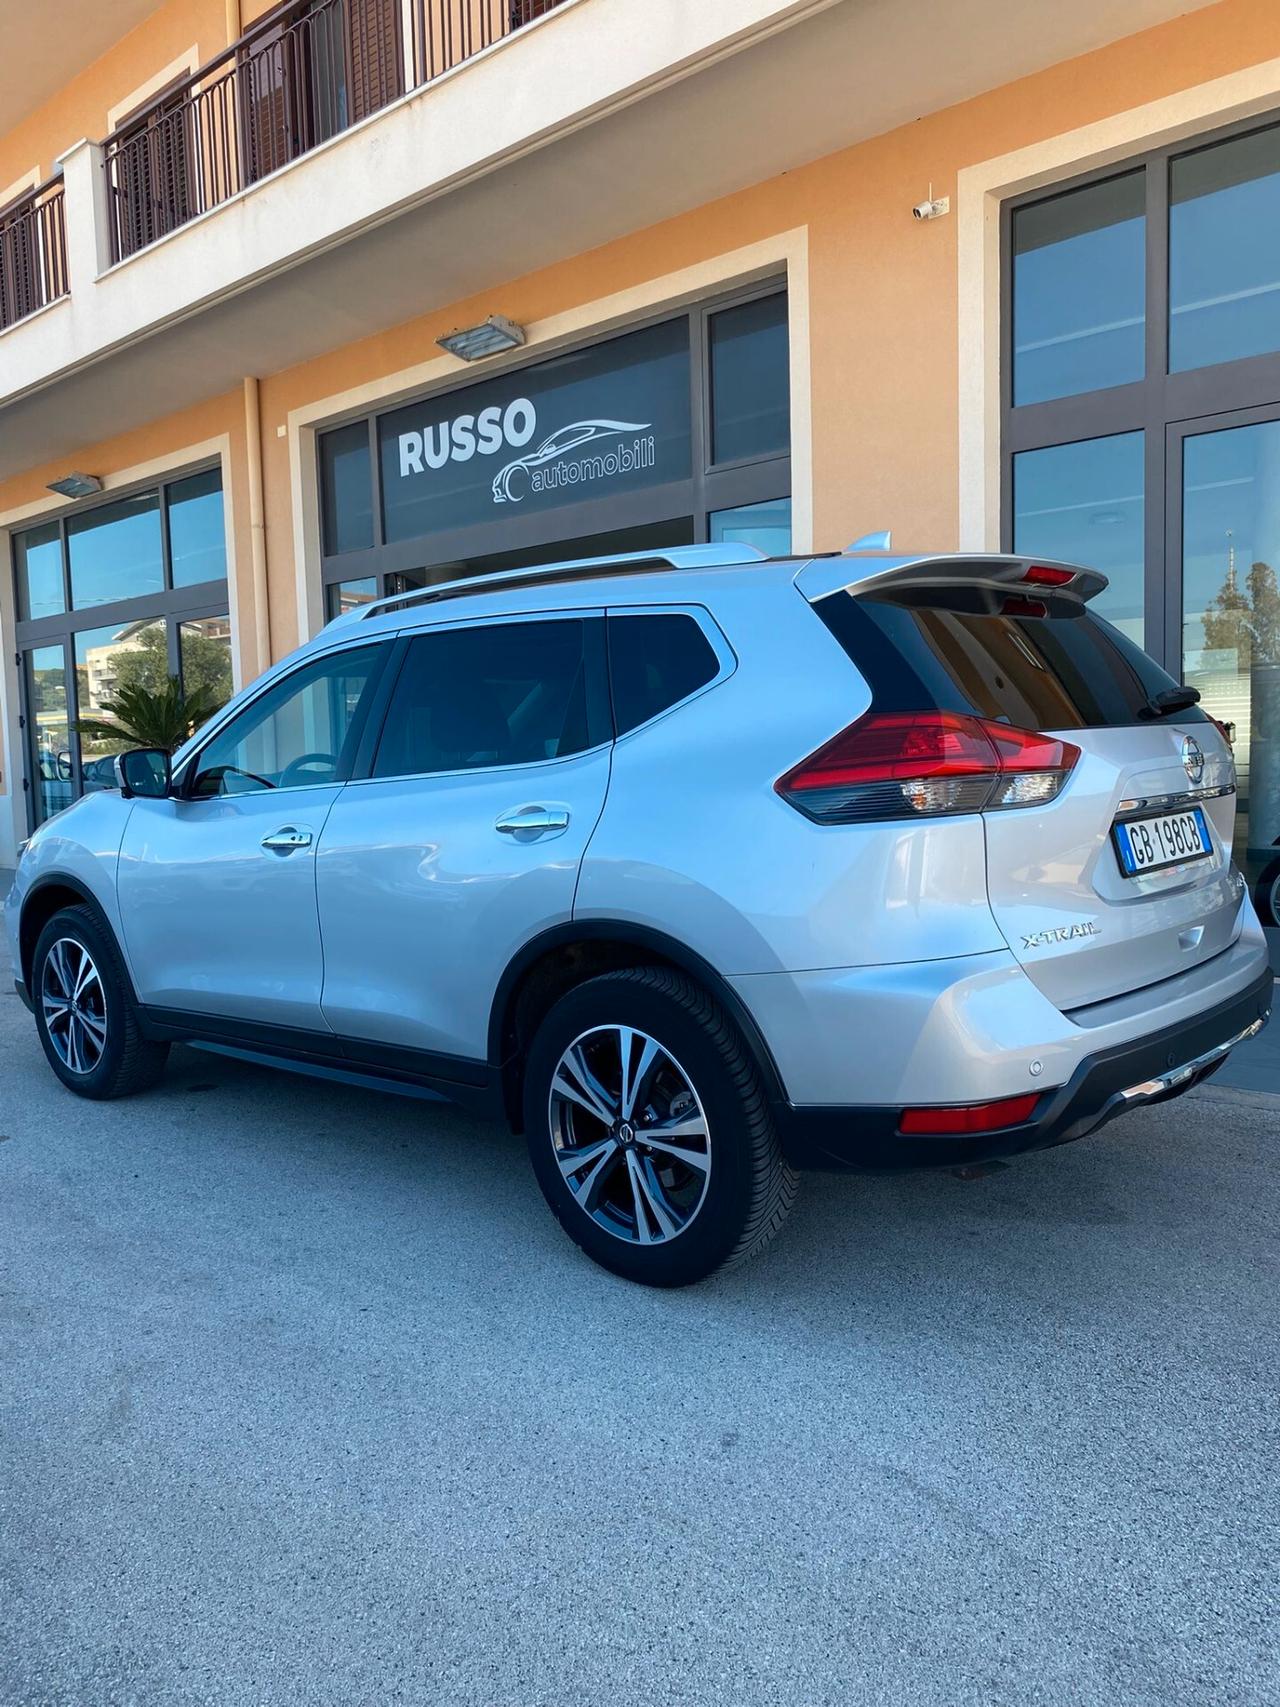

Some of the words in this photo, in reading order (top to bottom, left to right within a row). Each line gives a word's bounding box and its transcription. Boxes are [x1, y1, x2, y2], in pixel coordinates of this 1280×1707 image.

[398, 398, 536, 477] RUSSO
[531, 436, 655, 492] automobili
[1130, 824, 1154, 865] GB
[1155, 815, 1201, 860] 198CB
[1020, 921, 1102, 950] X-TRAIL
